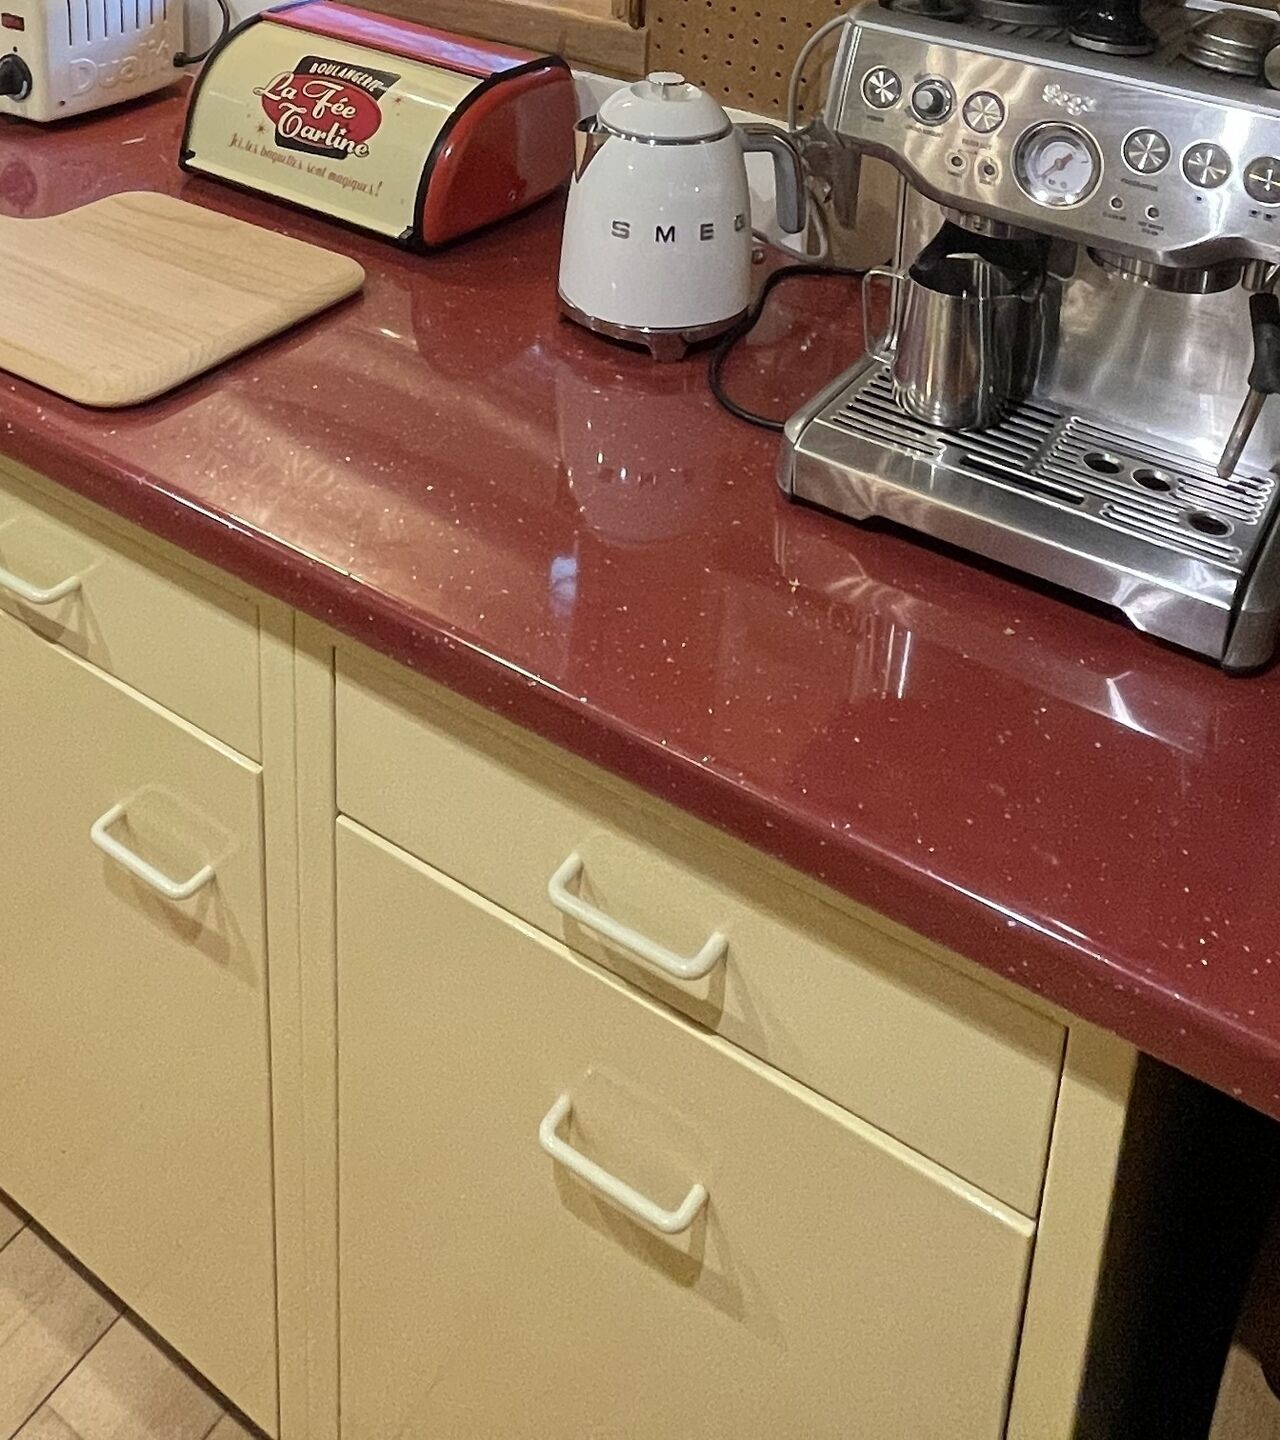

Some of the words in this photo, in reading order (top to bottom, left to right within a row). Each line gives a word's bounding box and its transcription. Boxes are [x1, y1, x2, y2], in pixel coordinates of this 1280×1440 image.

[253, 71, 298, 101] La
[302, 80, 357, 119] Fée
[309, 62, 383, 93] BOULANGERIE
[276, 102, 370, 158] Tartine
[610, 213, 746, 244] SMEG
